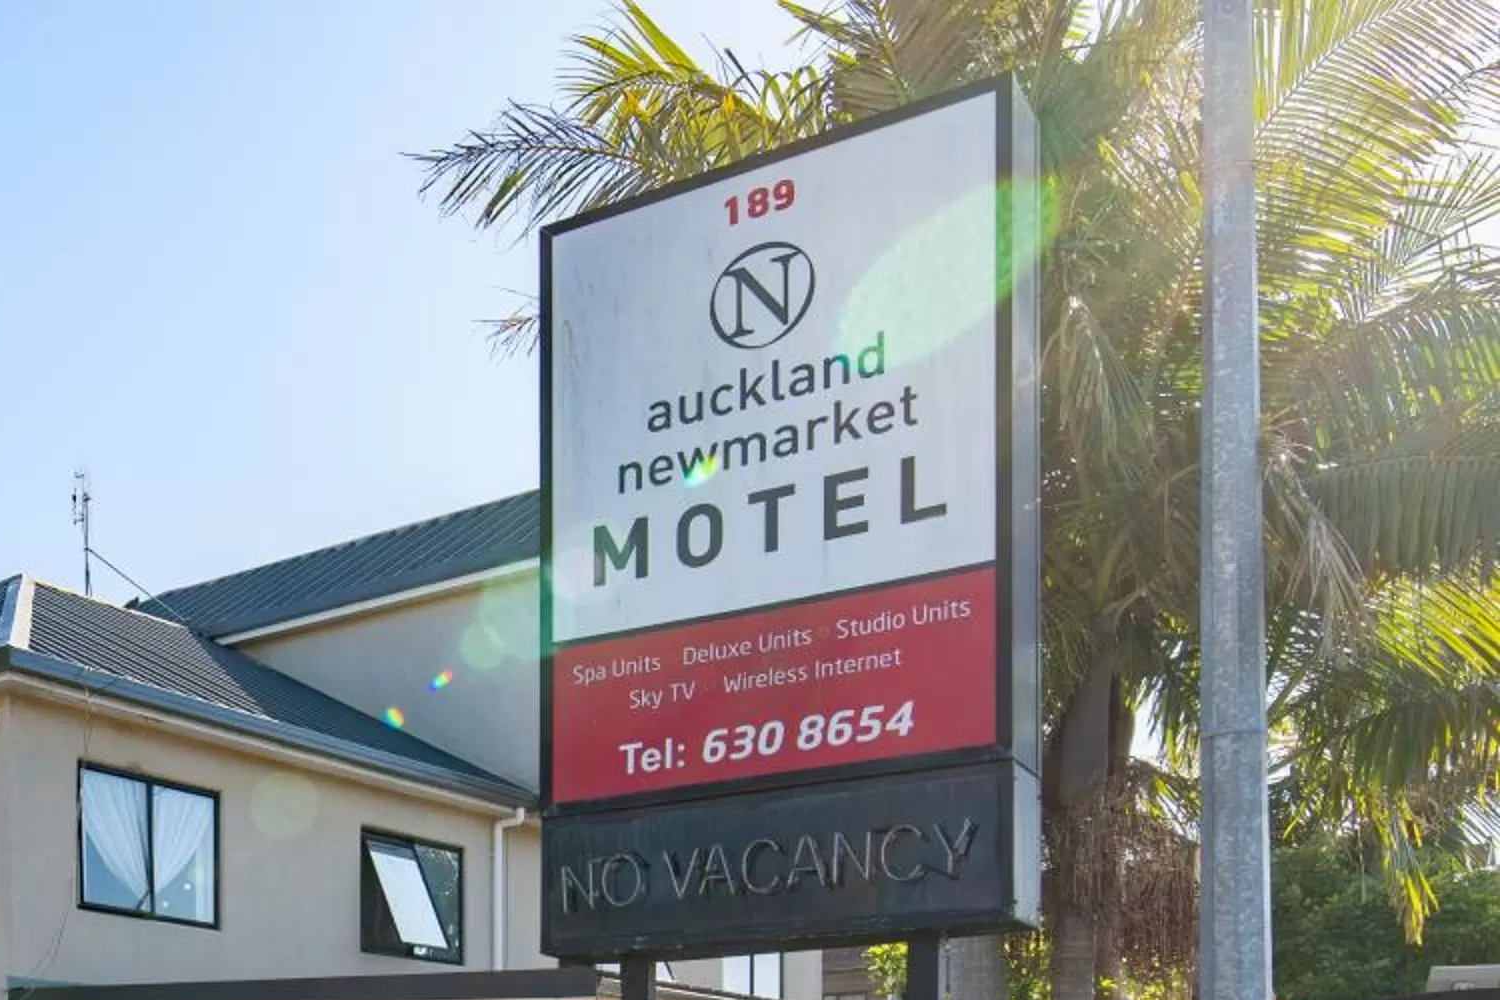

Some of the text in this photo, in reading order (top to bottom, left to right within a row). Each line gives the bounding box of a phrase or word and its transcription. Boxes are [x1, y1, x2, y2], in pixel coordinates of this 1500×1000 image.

[724, 179, 796, 226] 189
[722, 250, 802, 340] N
[647, 331, 885, 433] auckland
[618, 385, 918, 494] newmarket
[593, 456, 947, 587] MOTEL
[572, 598, 972, 687] Spa Units Deluxe Units Studio Units
[629, 648, 902, 710] Sky TV Wireless Internet
[618, 701, 915, 775] Tel: 630 8654
[561, 816, 978, 914] NO VACANCY
